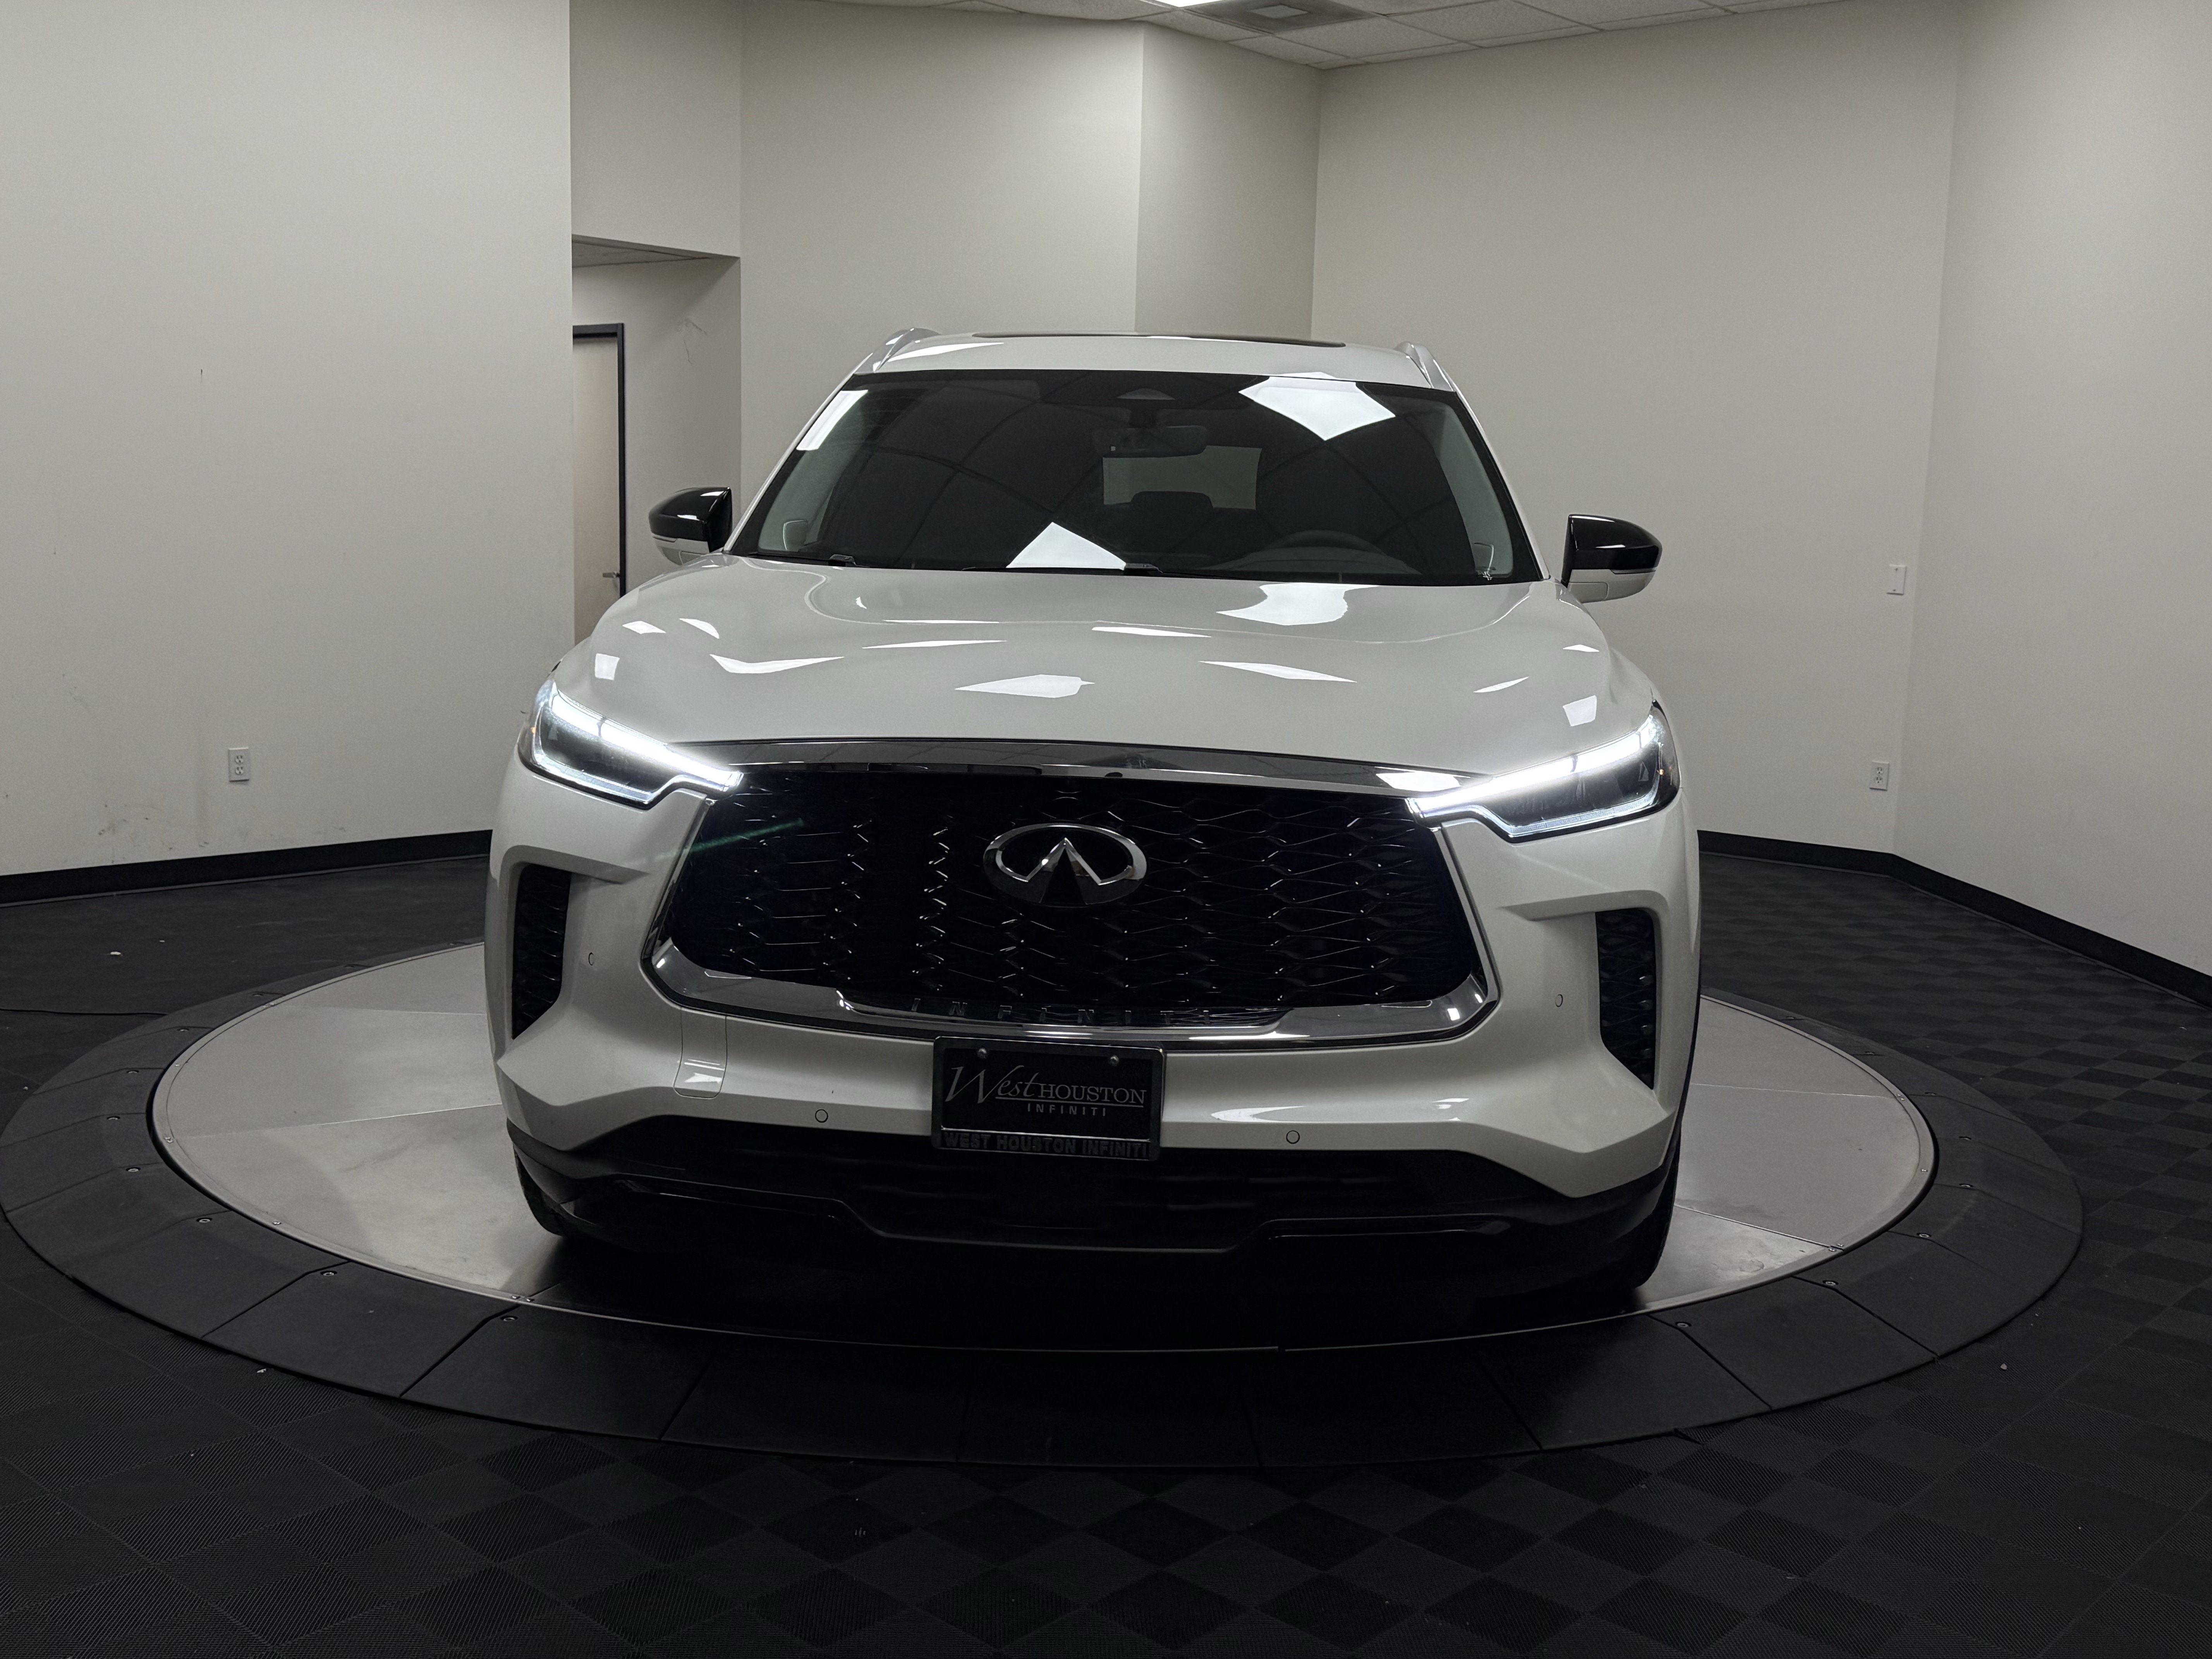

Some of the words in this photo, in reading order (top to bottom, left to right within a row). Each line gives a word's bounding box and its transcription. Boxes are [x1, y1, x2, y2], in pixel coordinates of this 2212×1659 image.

[1040, 1083, 1147, 1104] HOUSTON
[1027, 1103, 1107, 1117] INFINITI
[944, 1132, 991, 1149] WEST
[996, 1135, 1077, 1154] HOUSTON
[1084, 1139, 1148, 1158] INFINITI
